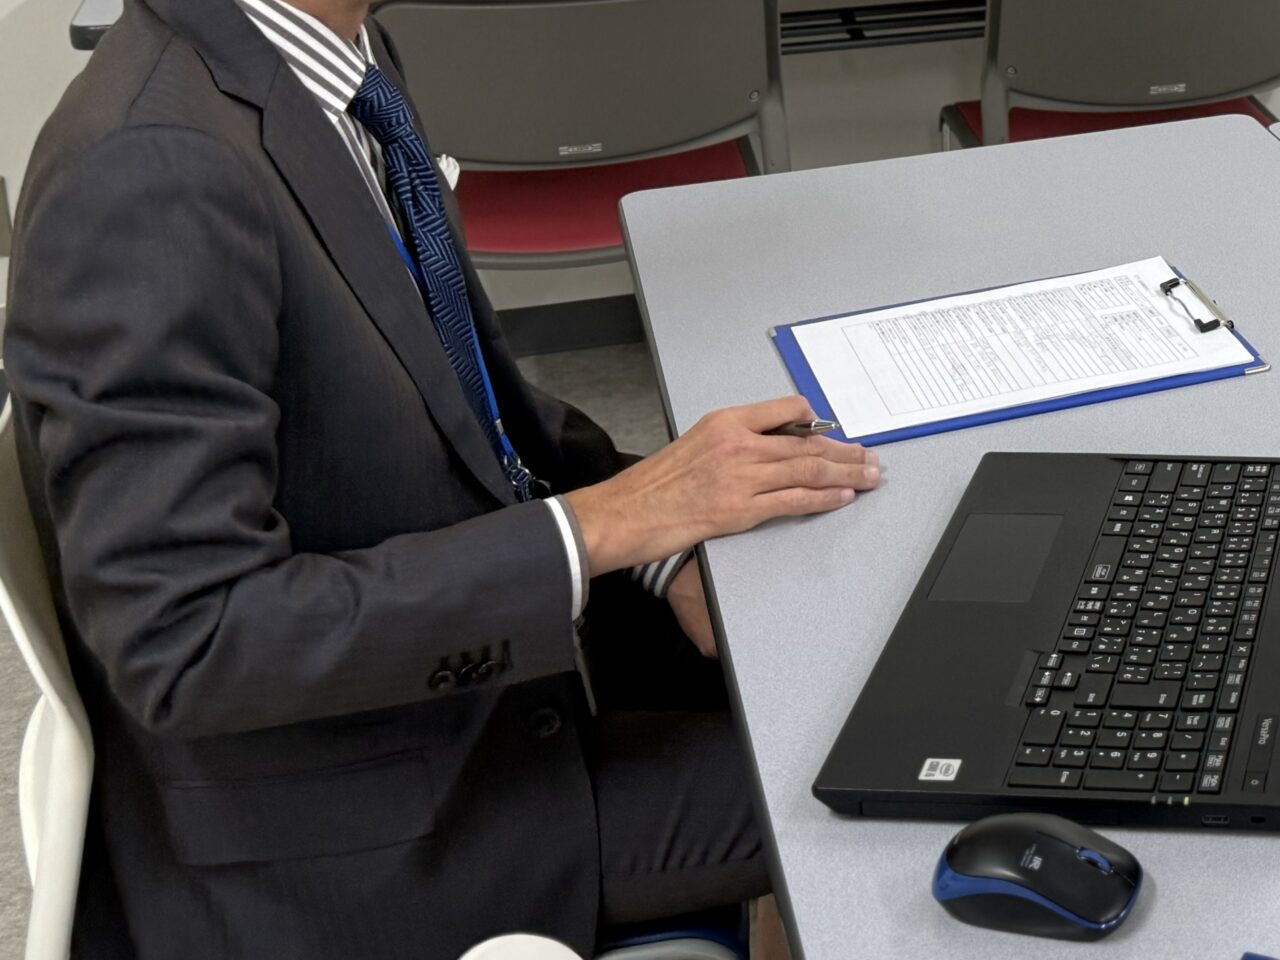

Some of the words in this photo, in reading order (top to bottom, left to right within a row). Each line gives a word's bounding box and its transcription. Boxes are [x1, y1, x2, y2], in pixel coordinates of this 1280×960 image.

[1158, 693, 1167, 704] Enter
[1258, 718, 1273, 745] VersaPro
[1060, 770, 1070, 783] Enter
